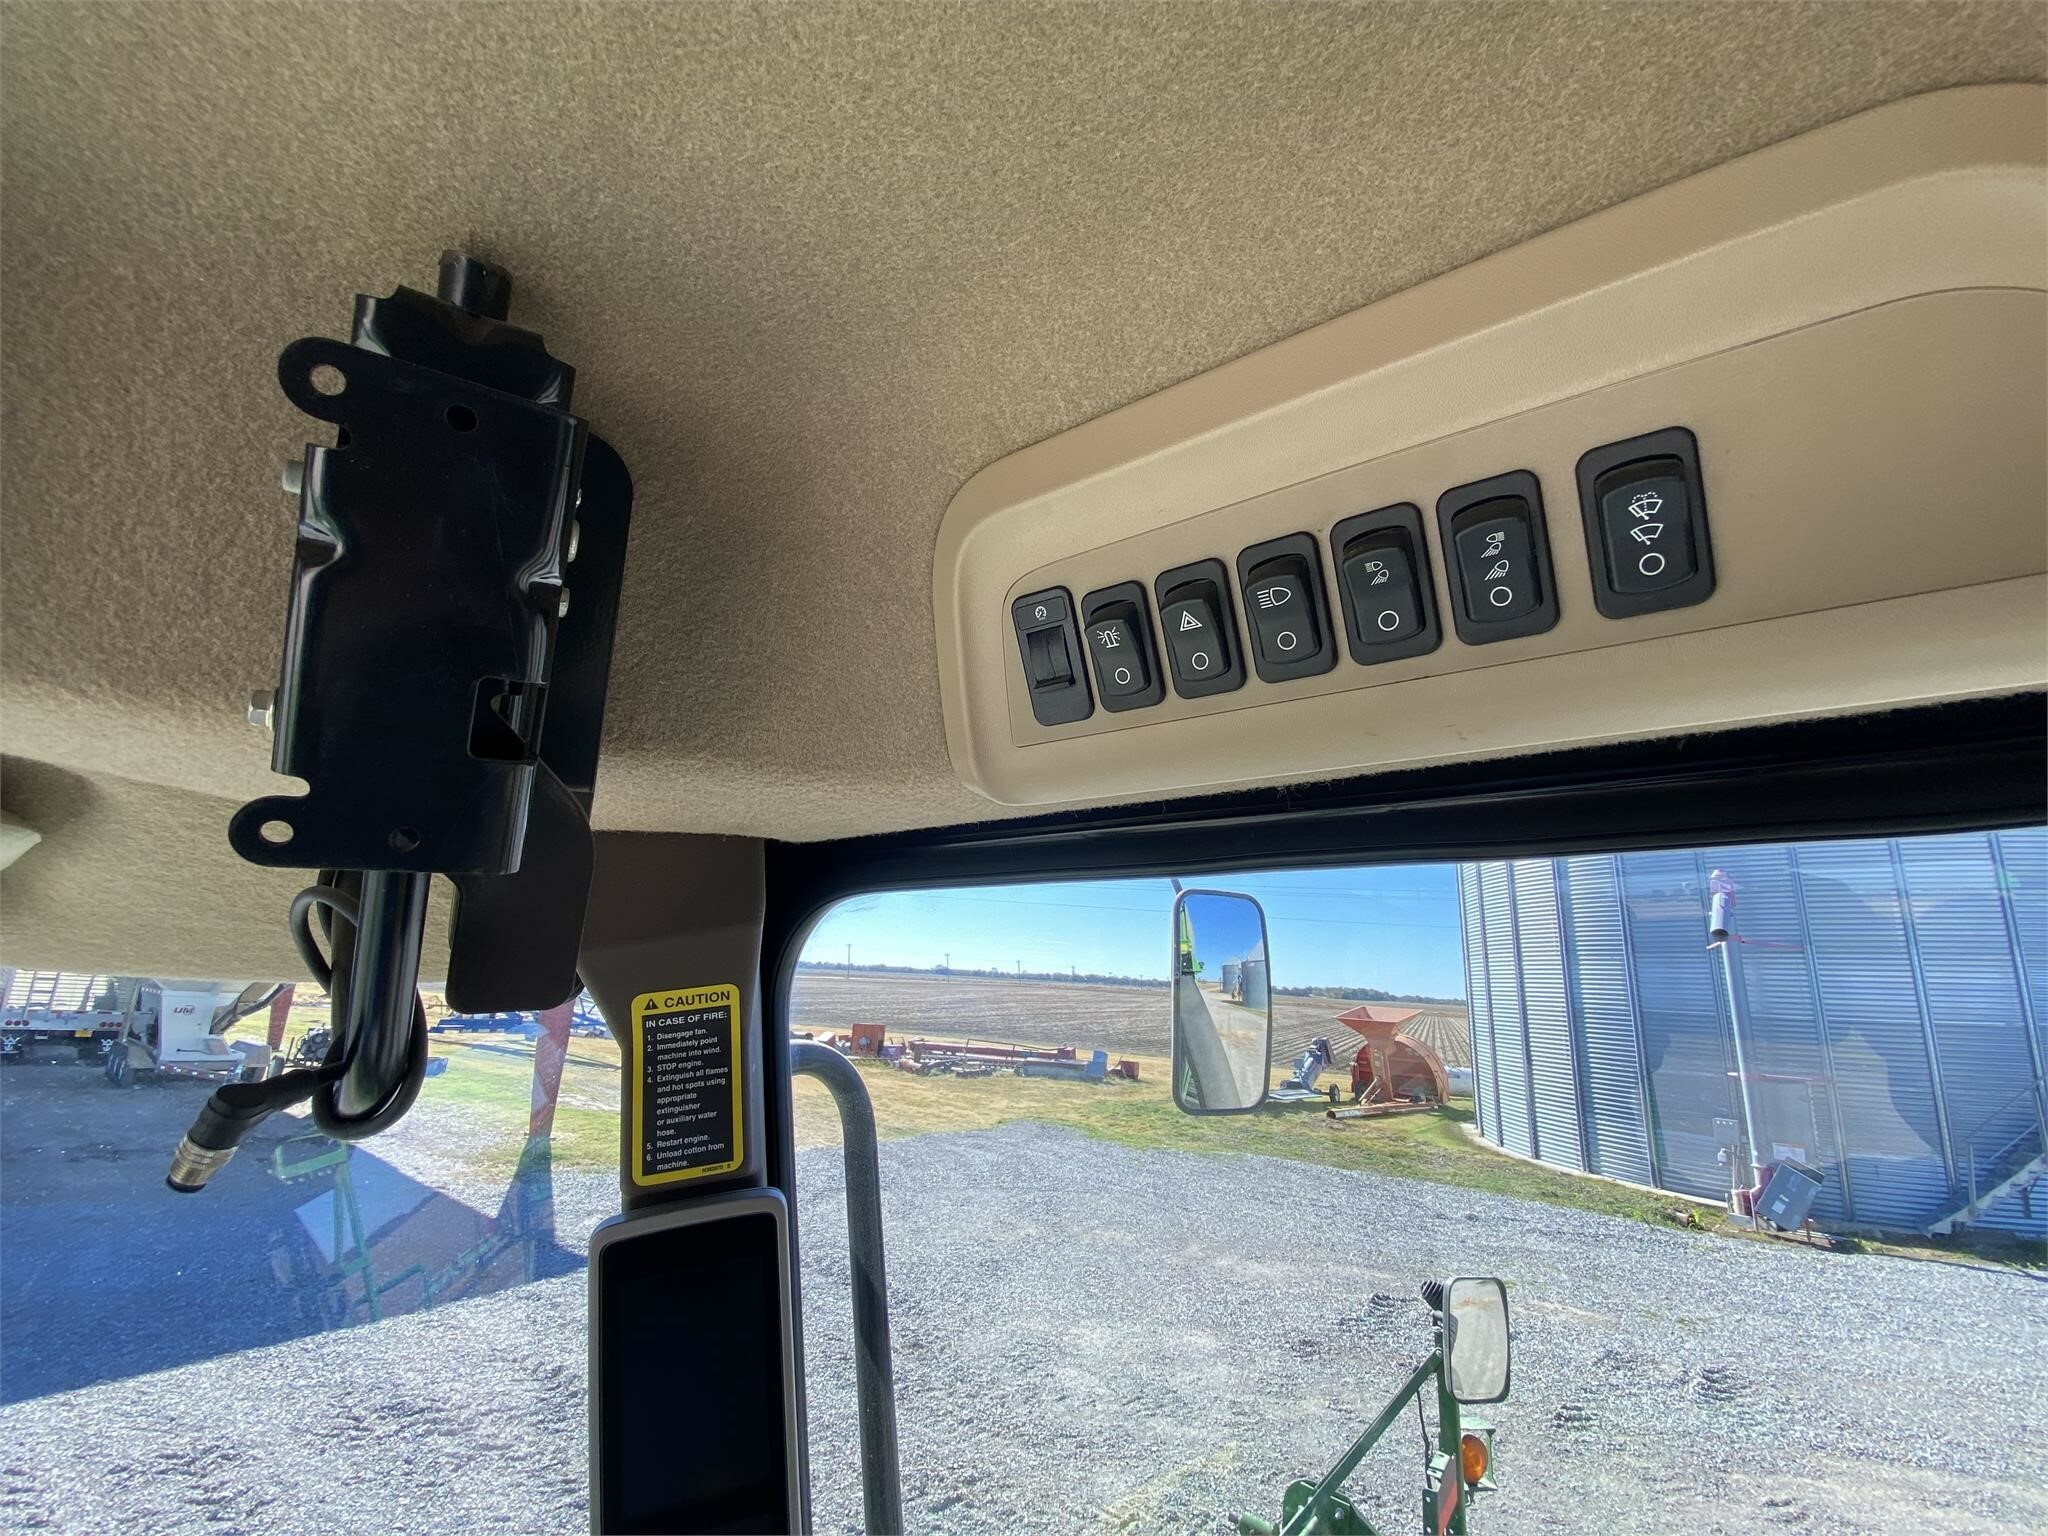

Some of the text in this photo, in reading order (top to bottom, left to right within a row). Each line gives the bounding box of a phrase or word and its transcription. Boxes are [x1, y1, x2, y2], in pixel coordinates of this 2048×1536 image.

[664, 991, 730, 1008] CAUTION
[659, 1017, 684, 1026] CASE
[703, 1012, 727, 1020] FIRE:
[657, 1030, 693, 1040] Disengage
[657, 1039, 698, 1050] Immediately
[700, 1036, 717, 1047] point
[657, 1052, 687, 1060] machine
[657, 1063, 676, 1071] STOP
[678, 1060, 704, 1069] engine.
[657, 1071, 694, 1082] Extinguish
[706, 1066, 728, 1075] flames
[686, 1081, 704, 1091] spots
[707, 1078, 725, 1087] using
[657, 1092, 697, 1105] appropriate
[657, 1102, 700, 1115] extinguisher
[666, 1114, 695, 1124] auxiliary
[698, 1111, 717, 1119] water
[657, 1128, 676, 1137] hose.
[657, 1138, 682, 1148] Restart
[684, 1134, 710, 1143] engine.
[657, 1150, 682, 1159] Unload
[684, 1146, 706, 1156] cotton
[708, 1143, 724, 1152] from
[657, 1160, 689, 1171] machine.
